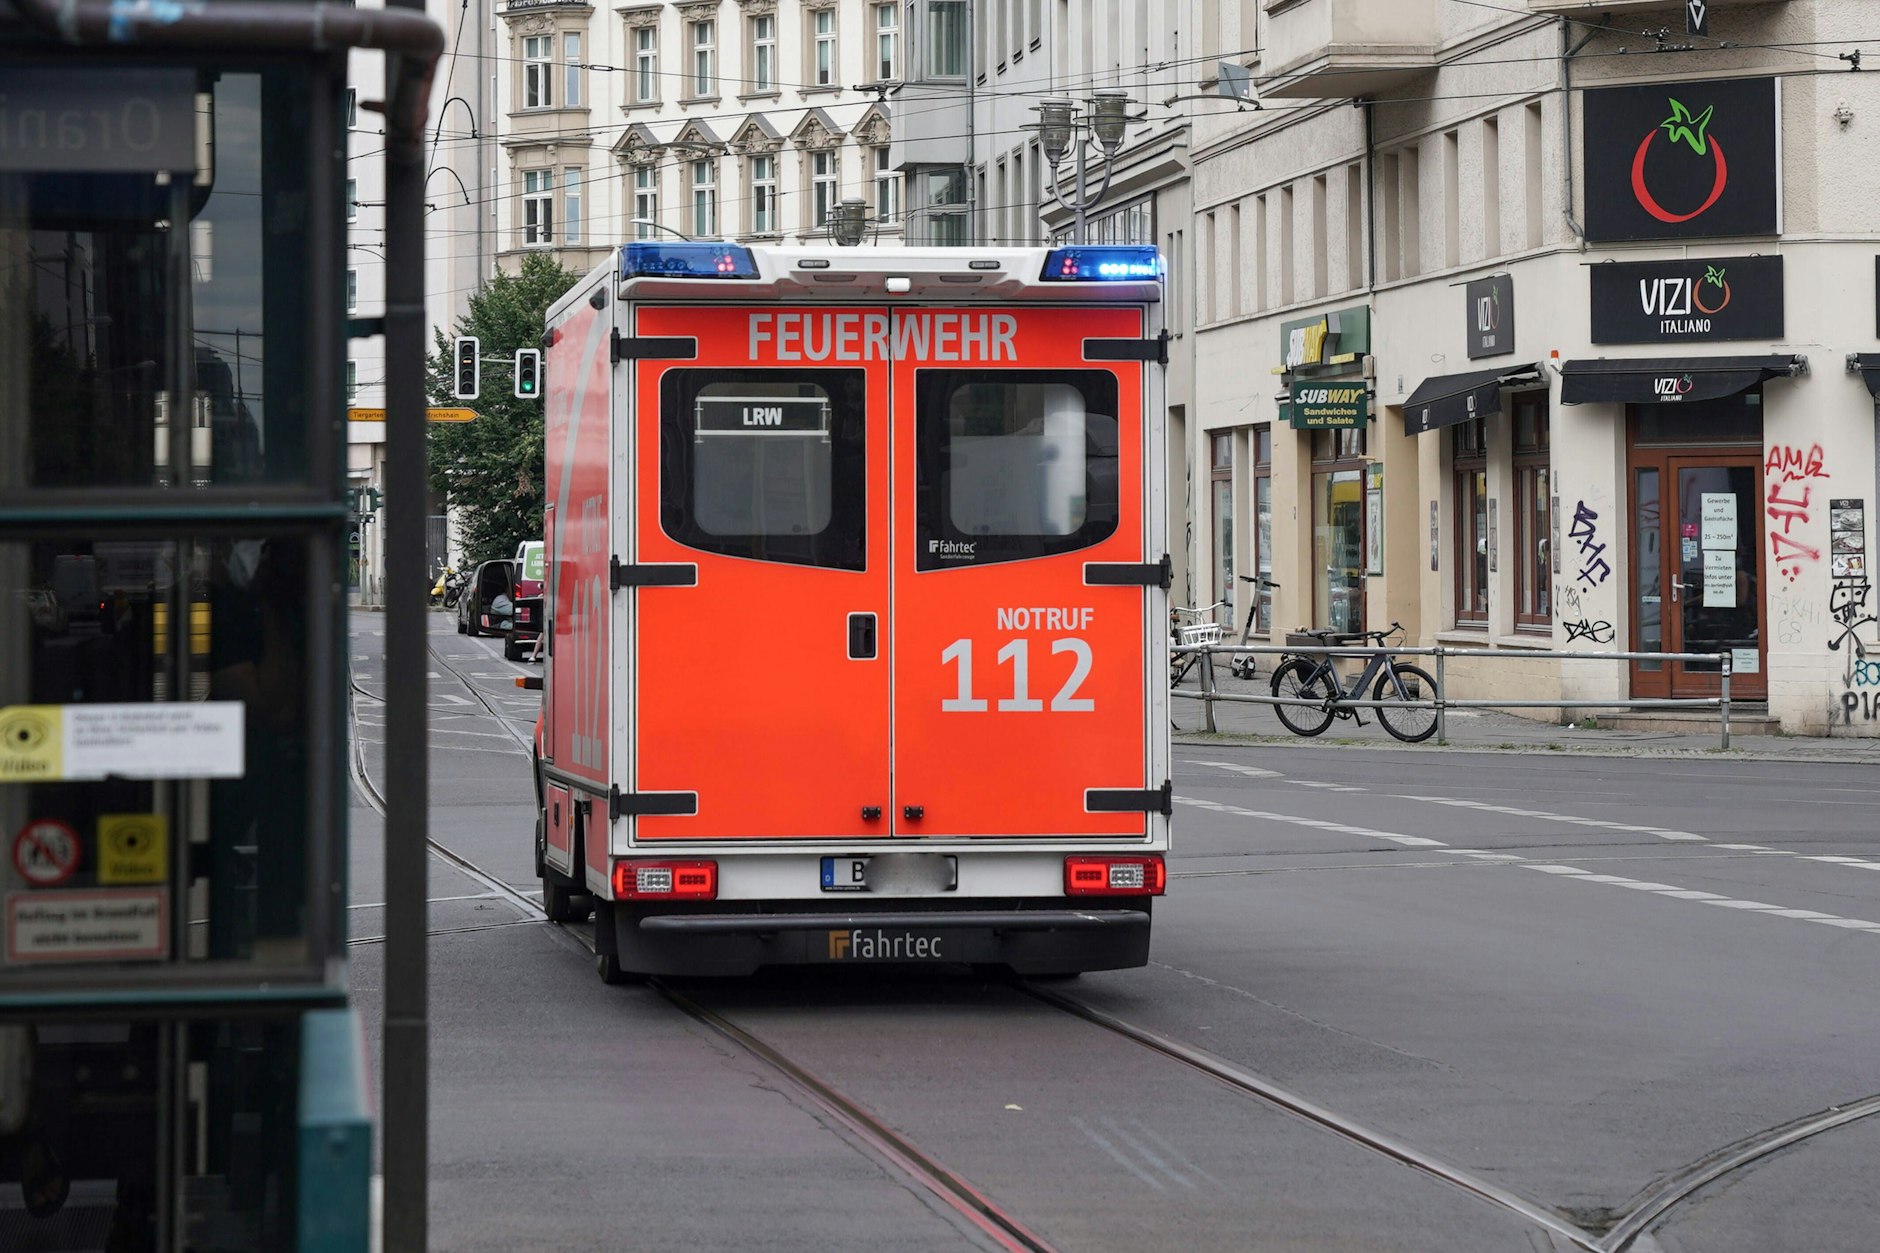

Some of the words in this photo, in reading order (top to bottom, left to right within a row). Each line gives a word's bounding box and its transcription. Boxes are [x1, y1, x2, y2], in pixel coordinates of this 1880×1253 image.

[1660, 319, 1711, 333] ITALIANO
[748, 313, 1018, 361] FEUERWEHR
[1295, 388, 1365, 404] SUBWAY
[353, 411, 384, 419] Tiergarten
[743, 407, 783, 425] LRW
[1303, 407, 1357, 416] Sandwiches
[997, 607, 1095, 630] NOTRUF
[942, 637, 1095, 712] 112
[853, 929, 942, 958] fahrtec
